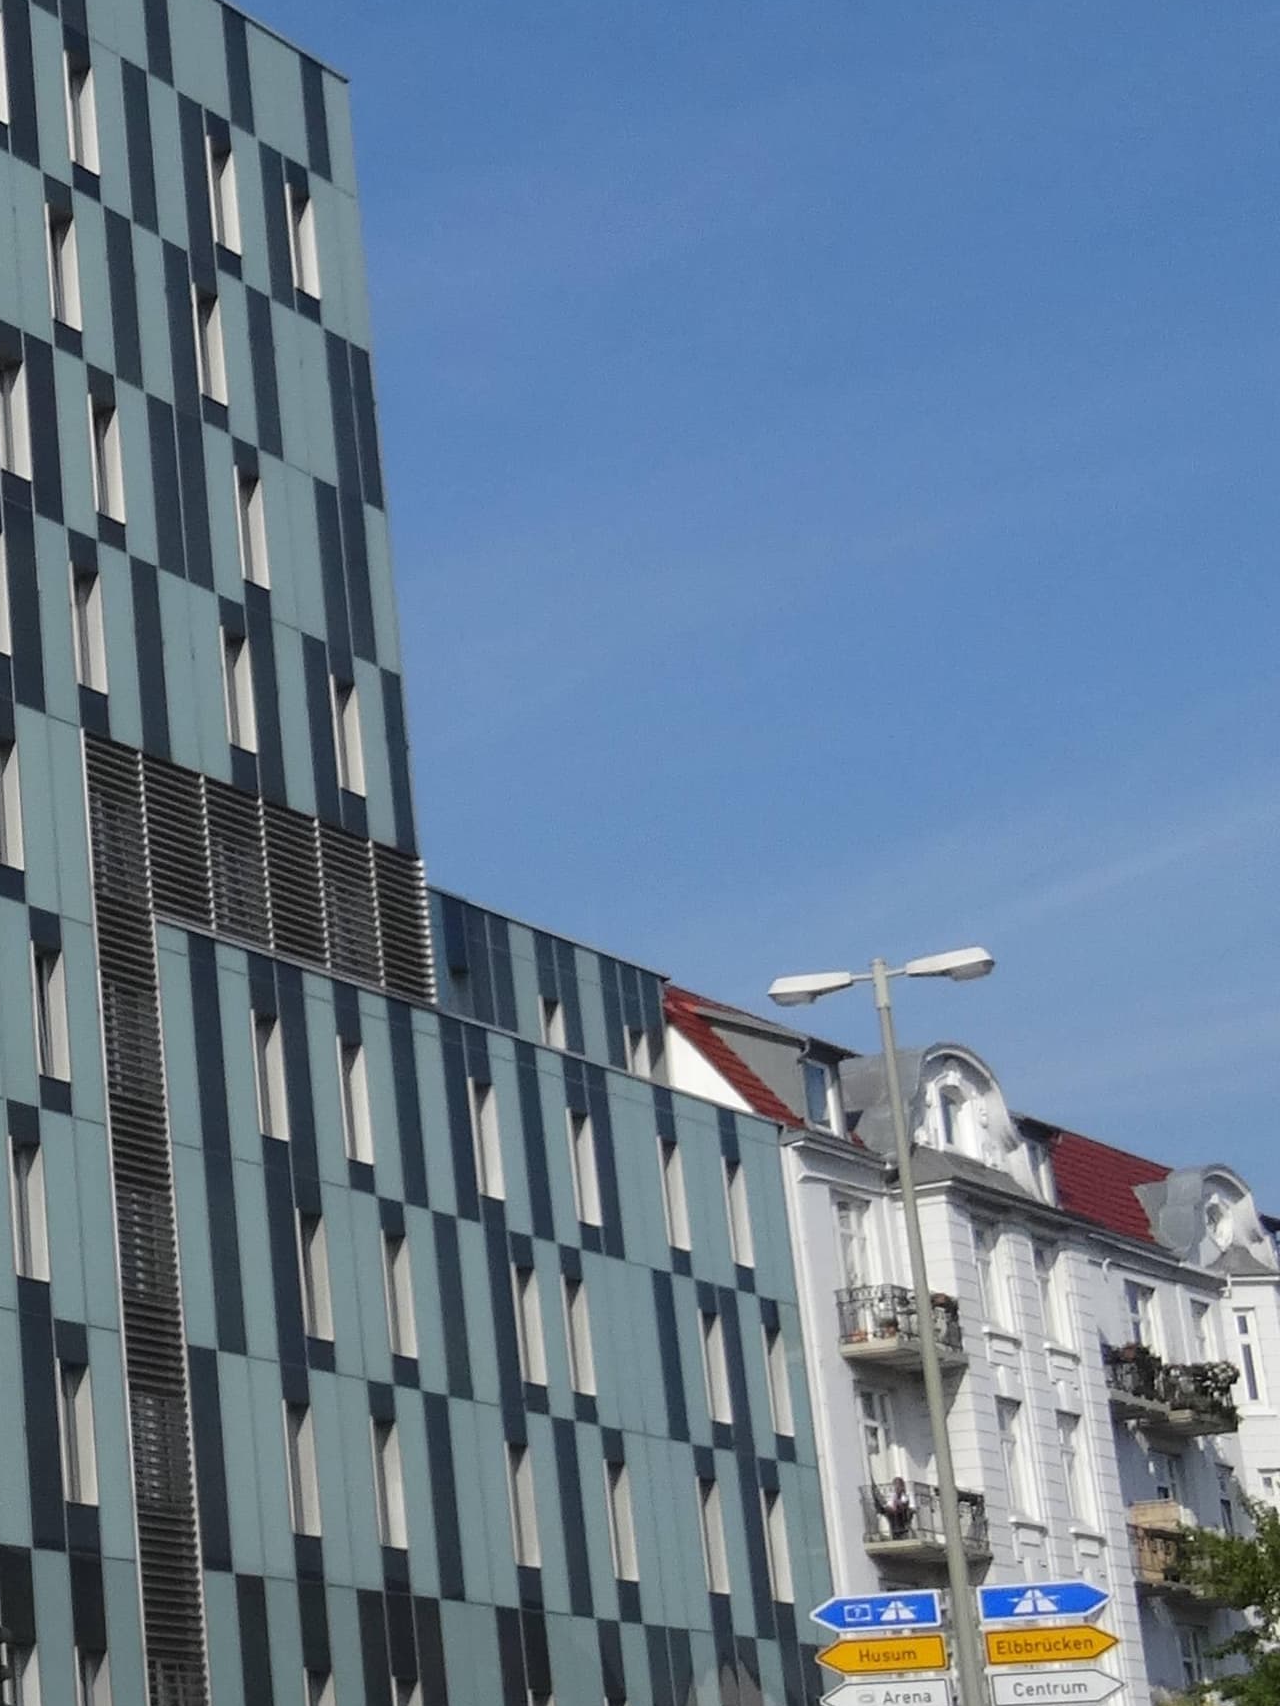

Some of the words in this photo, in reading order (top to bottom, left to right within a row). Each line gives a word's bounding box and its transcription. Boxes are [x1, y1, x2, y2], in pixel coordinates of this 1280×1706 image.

[996, 1636, 1094, 1655] Elbbrücken
[858, 1648, 918, 1663] Husum
[1012, 1682, 1088, 1697] Centrum
[882, 1691, 932, 1705] Arena
